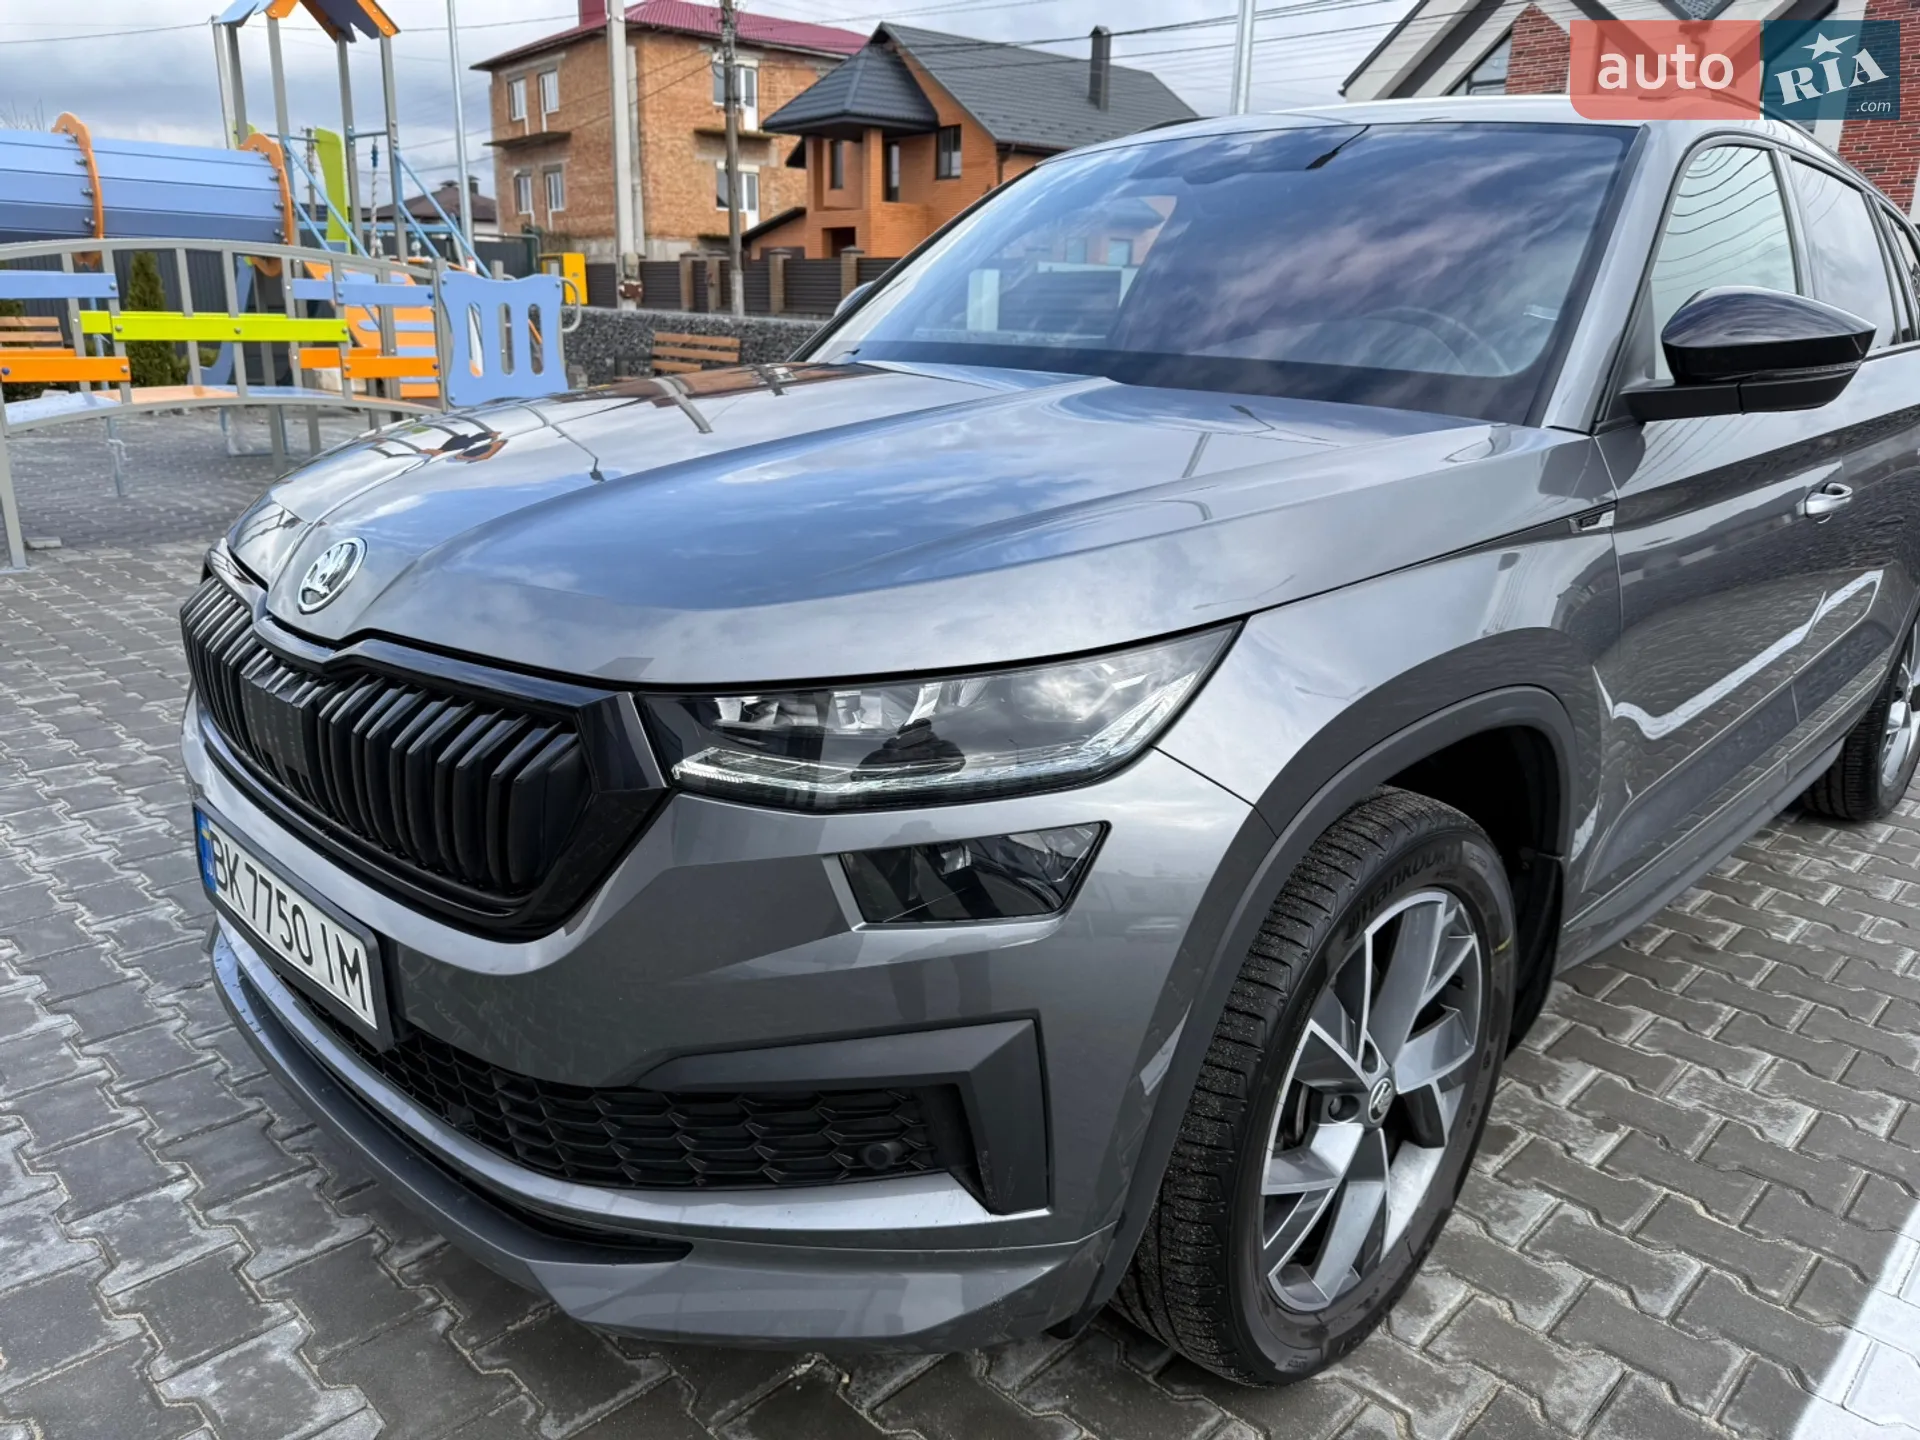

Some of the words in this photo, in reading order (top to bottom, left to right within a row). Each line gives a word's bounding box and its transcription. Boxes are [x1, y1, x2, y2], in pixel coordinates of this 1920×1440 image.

[209, 829, 246, 912] BK
[245, 861, 314, 967] 7750
[320, 922, 368, 1012] IM
